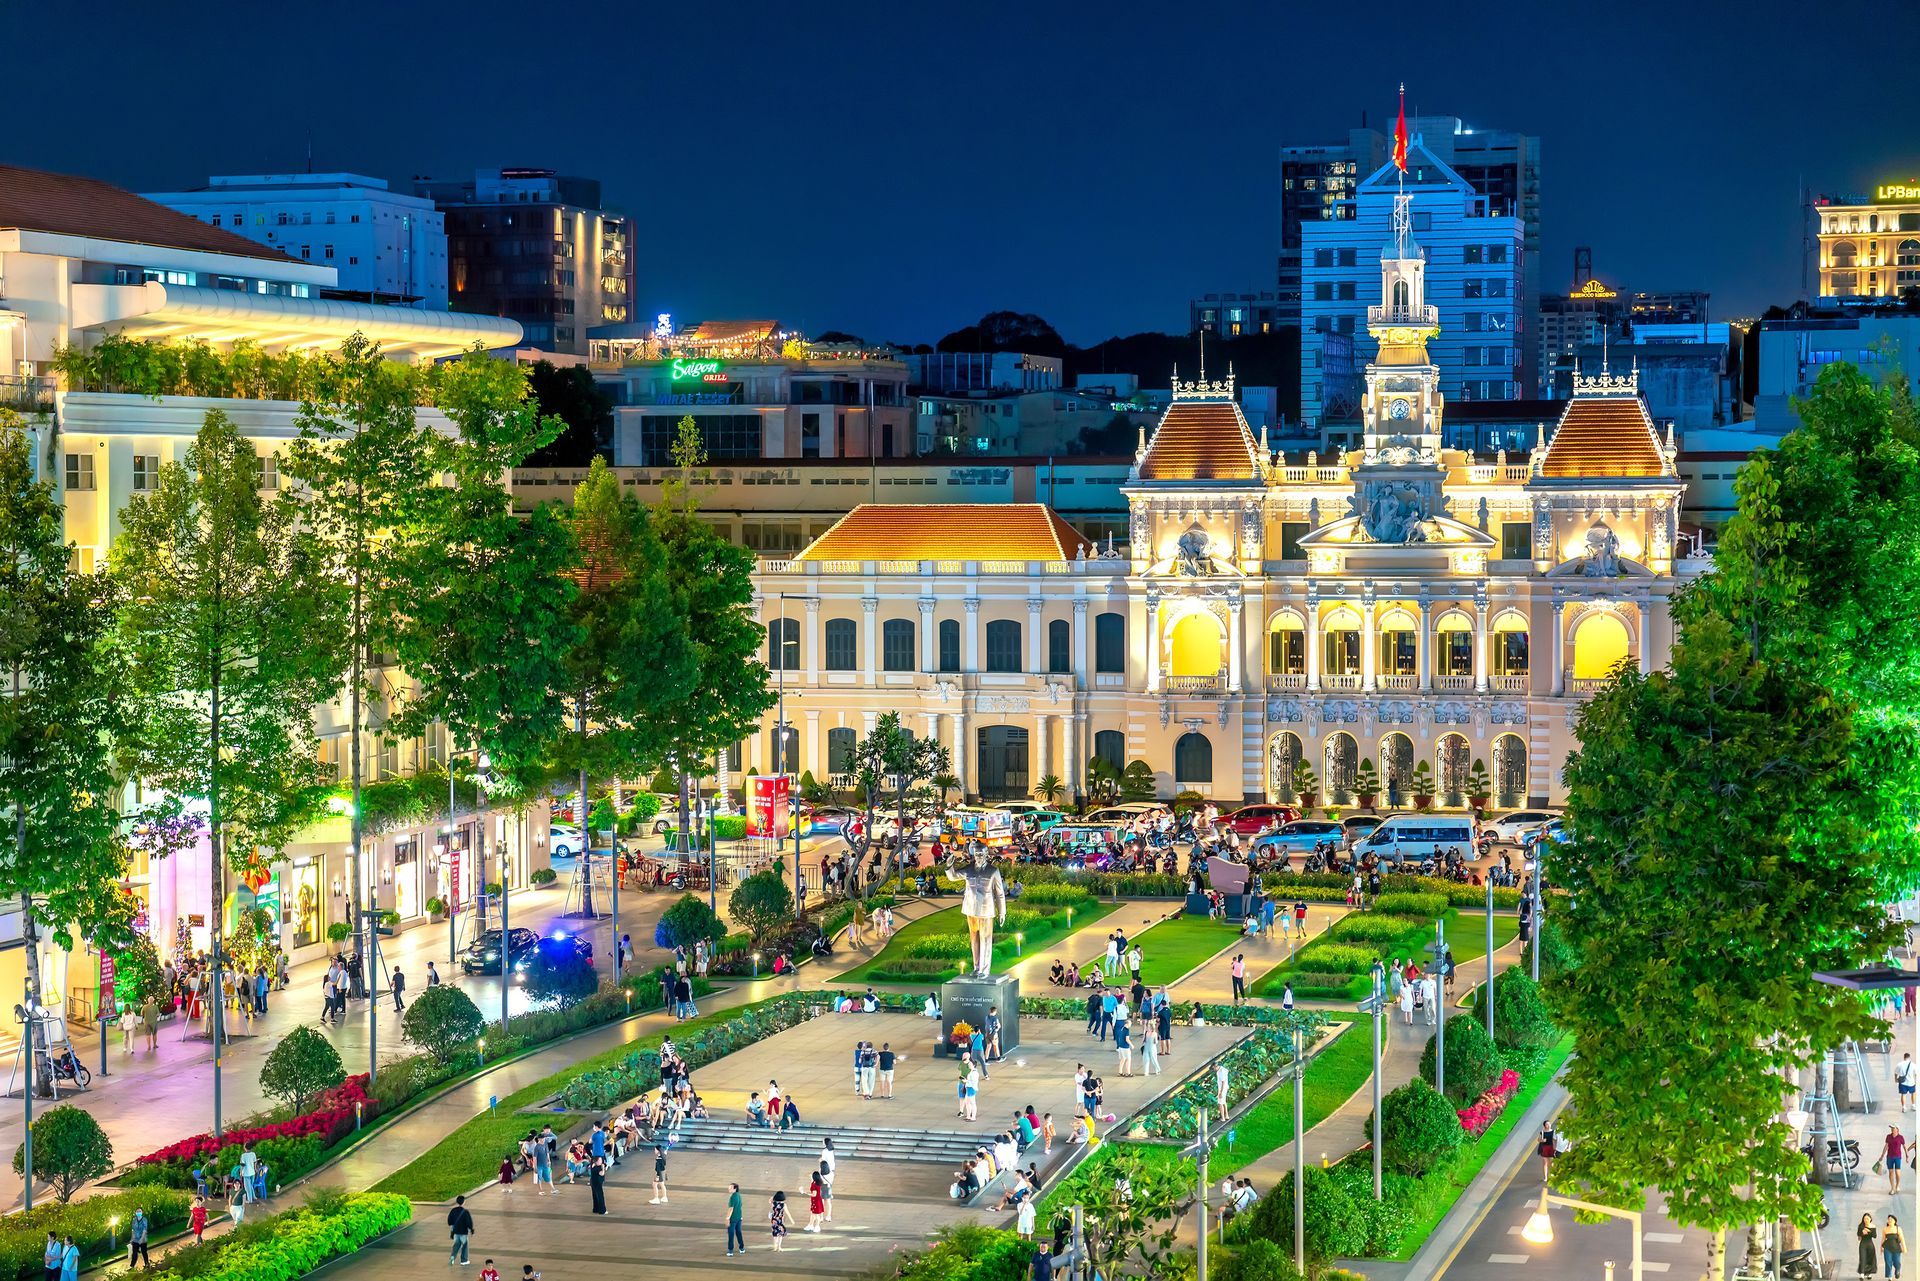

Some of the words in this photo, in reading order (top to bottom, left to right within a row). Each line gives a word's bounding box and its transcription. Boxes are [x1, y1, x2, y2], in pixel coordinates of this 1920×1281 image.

[1879, 186, 1920, 199] LPBan
[672, 358, 718, 380] Saigon
[703, 374, 728, 382] GRILL
[656, 394, 693, 405] MIRAE
